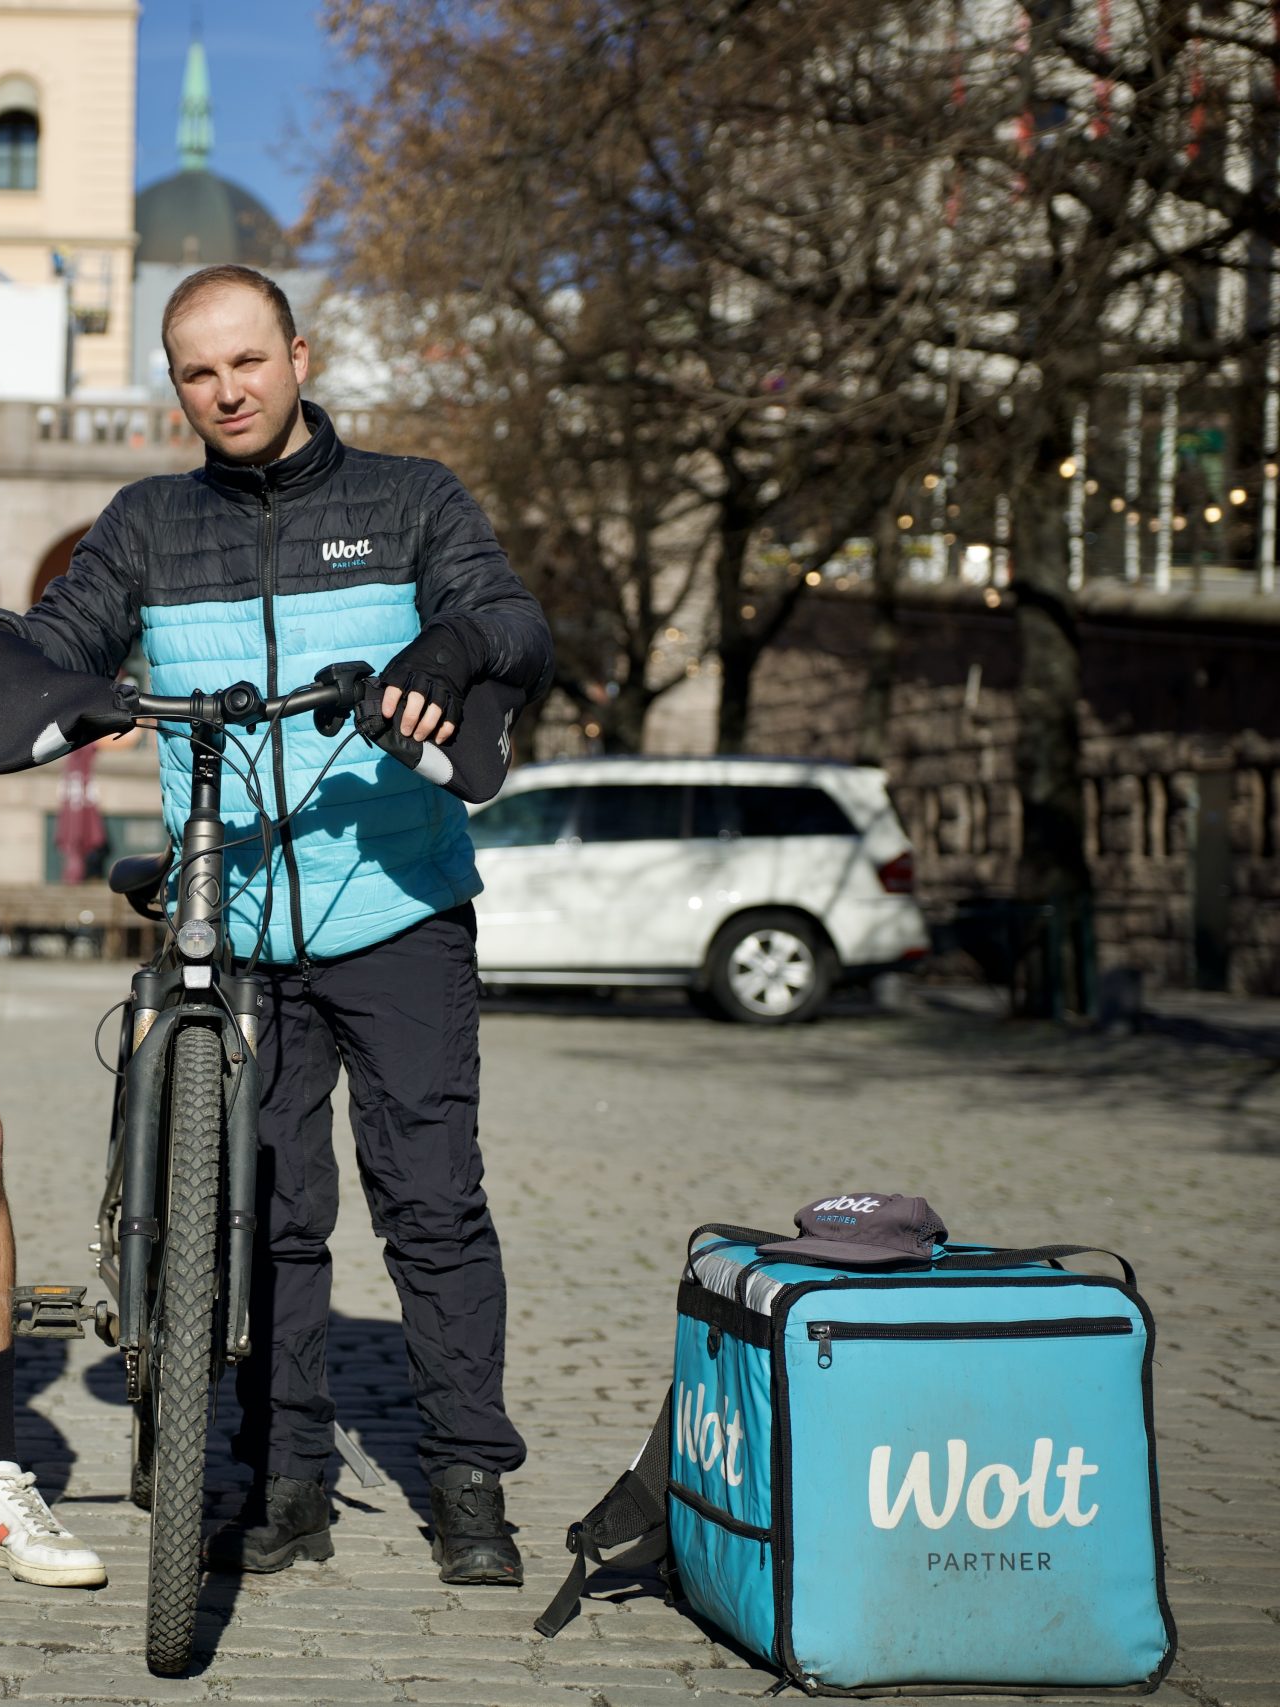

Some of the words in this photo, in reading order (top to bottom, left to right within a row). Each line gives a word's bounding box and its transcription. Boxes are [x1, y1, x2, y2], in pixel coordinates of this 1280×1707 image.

[322, 538, 373, 561] Wolt
[813, 1195, 880, 1213] Wolt
[816, 1214, 857, 1225] PARTNER
[868, 1437, 1100, 1530] Wolt
[927, 1551, 1052, 1572] PARTNER
